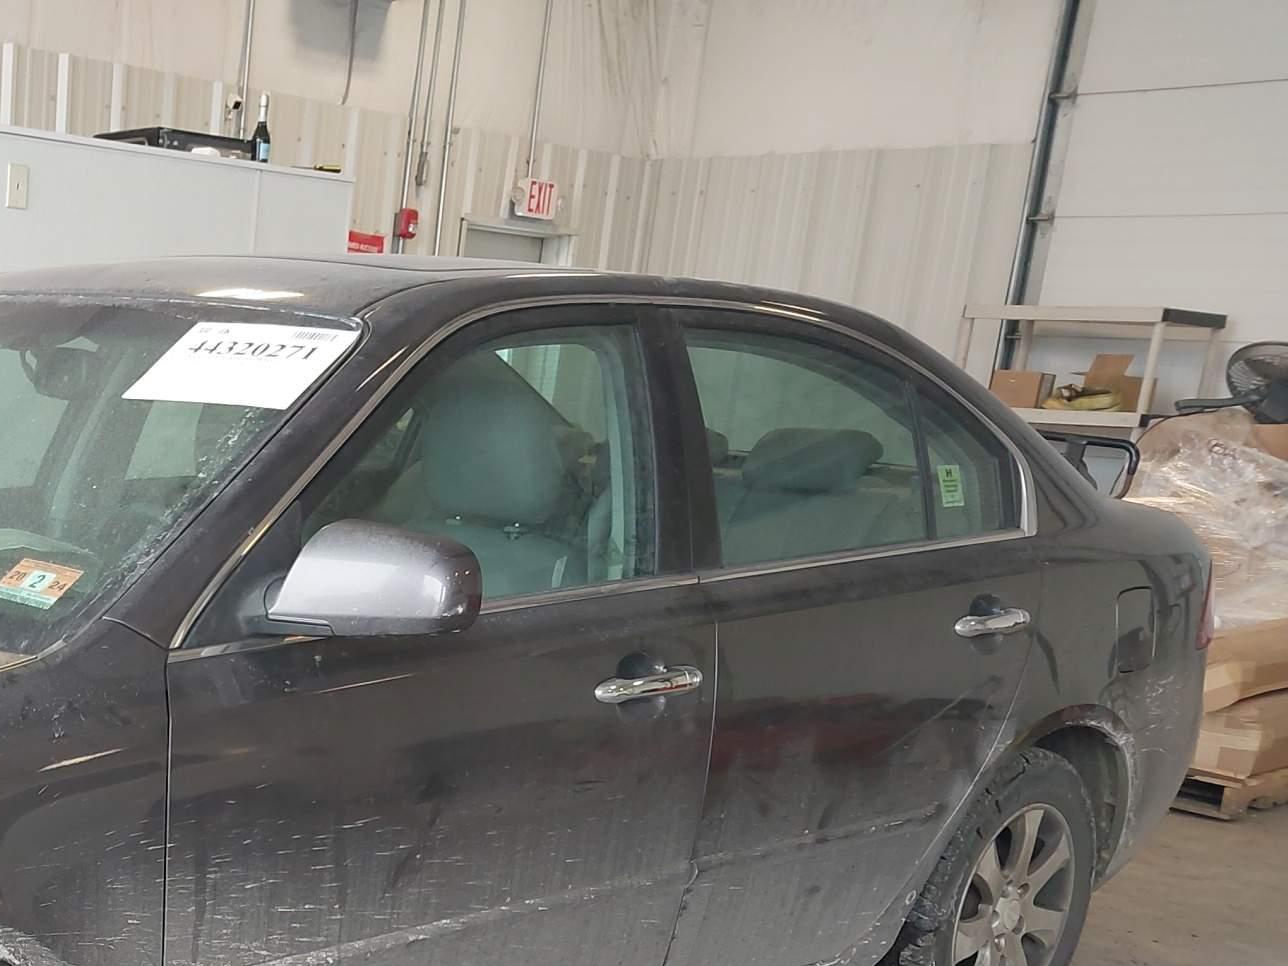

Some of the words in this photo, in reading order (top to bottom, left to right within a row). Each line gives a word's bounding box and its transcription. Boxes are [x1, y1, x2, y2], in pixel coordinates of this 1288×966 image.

[528, 180, 554, 216] EXIT
[188, 340, 319, 360] 44320271
[9, 570, 27, 581] 20
[28, 574, 46, 588] 2
[48, 581, 67, 591] 24
